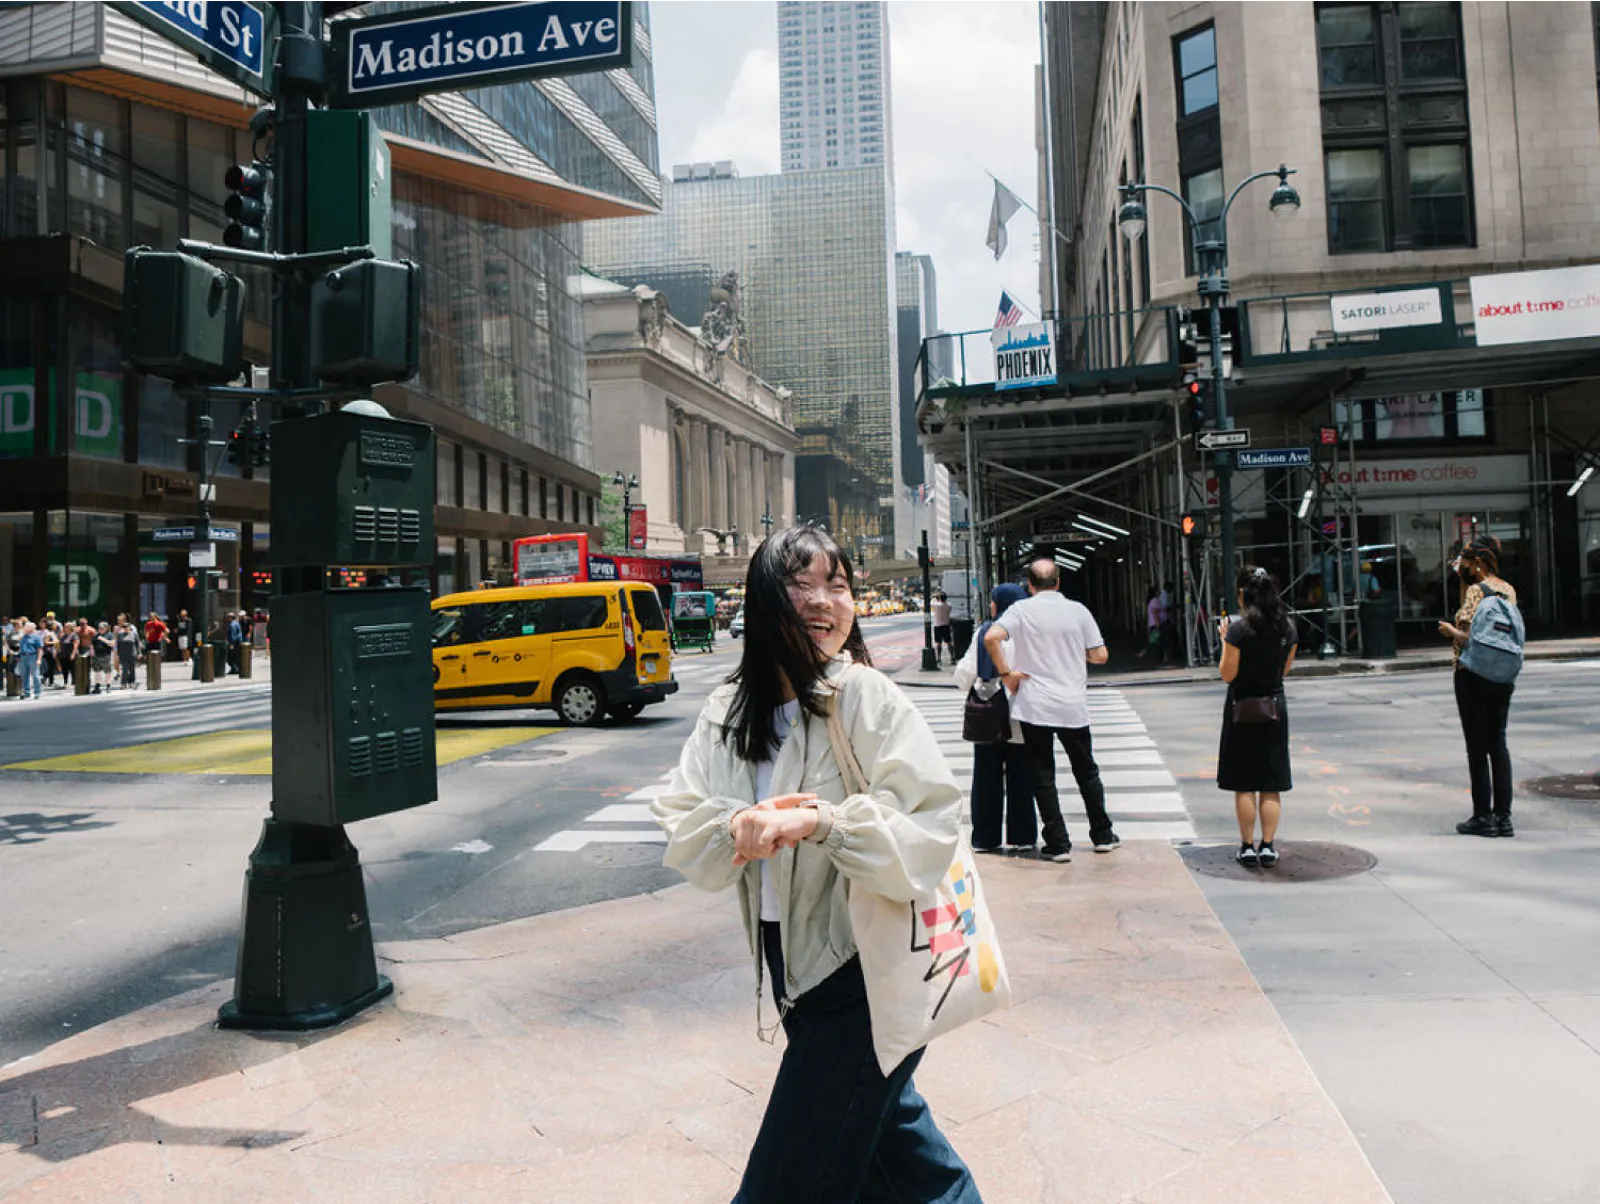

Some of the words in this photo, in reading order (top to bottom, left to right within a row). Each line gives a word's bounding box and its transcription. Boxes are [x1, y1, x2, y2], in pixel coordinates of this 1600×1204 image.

[220, 6, 253, 58] St
[355, 30, 525, 79] Madison
[537, 14, 617, 52] Ave
[1340, 306, 1386, 320] SATORI
[1478, 301, 1523, 318] about
[1526, 299, 1565, 313] t:me
[997, 347, 1053, 381] PHOENIX
[1417, 390, 1477, 404] LAER
[1240, 453, 1286, 465] Madison
[1289, 451, 1309, 462] Ave
[1373, 466, 1417, 482] t:me
[1420, 463, 1477, 481] coffee
[46, 564, 100, 607] TD
